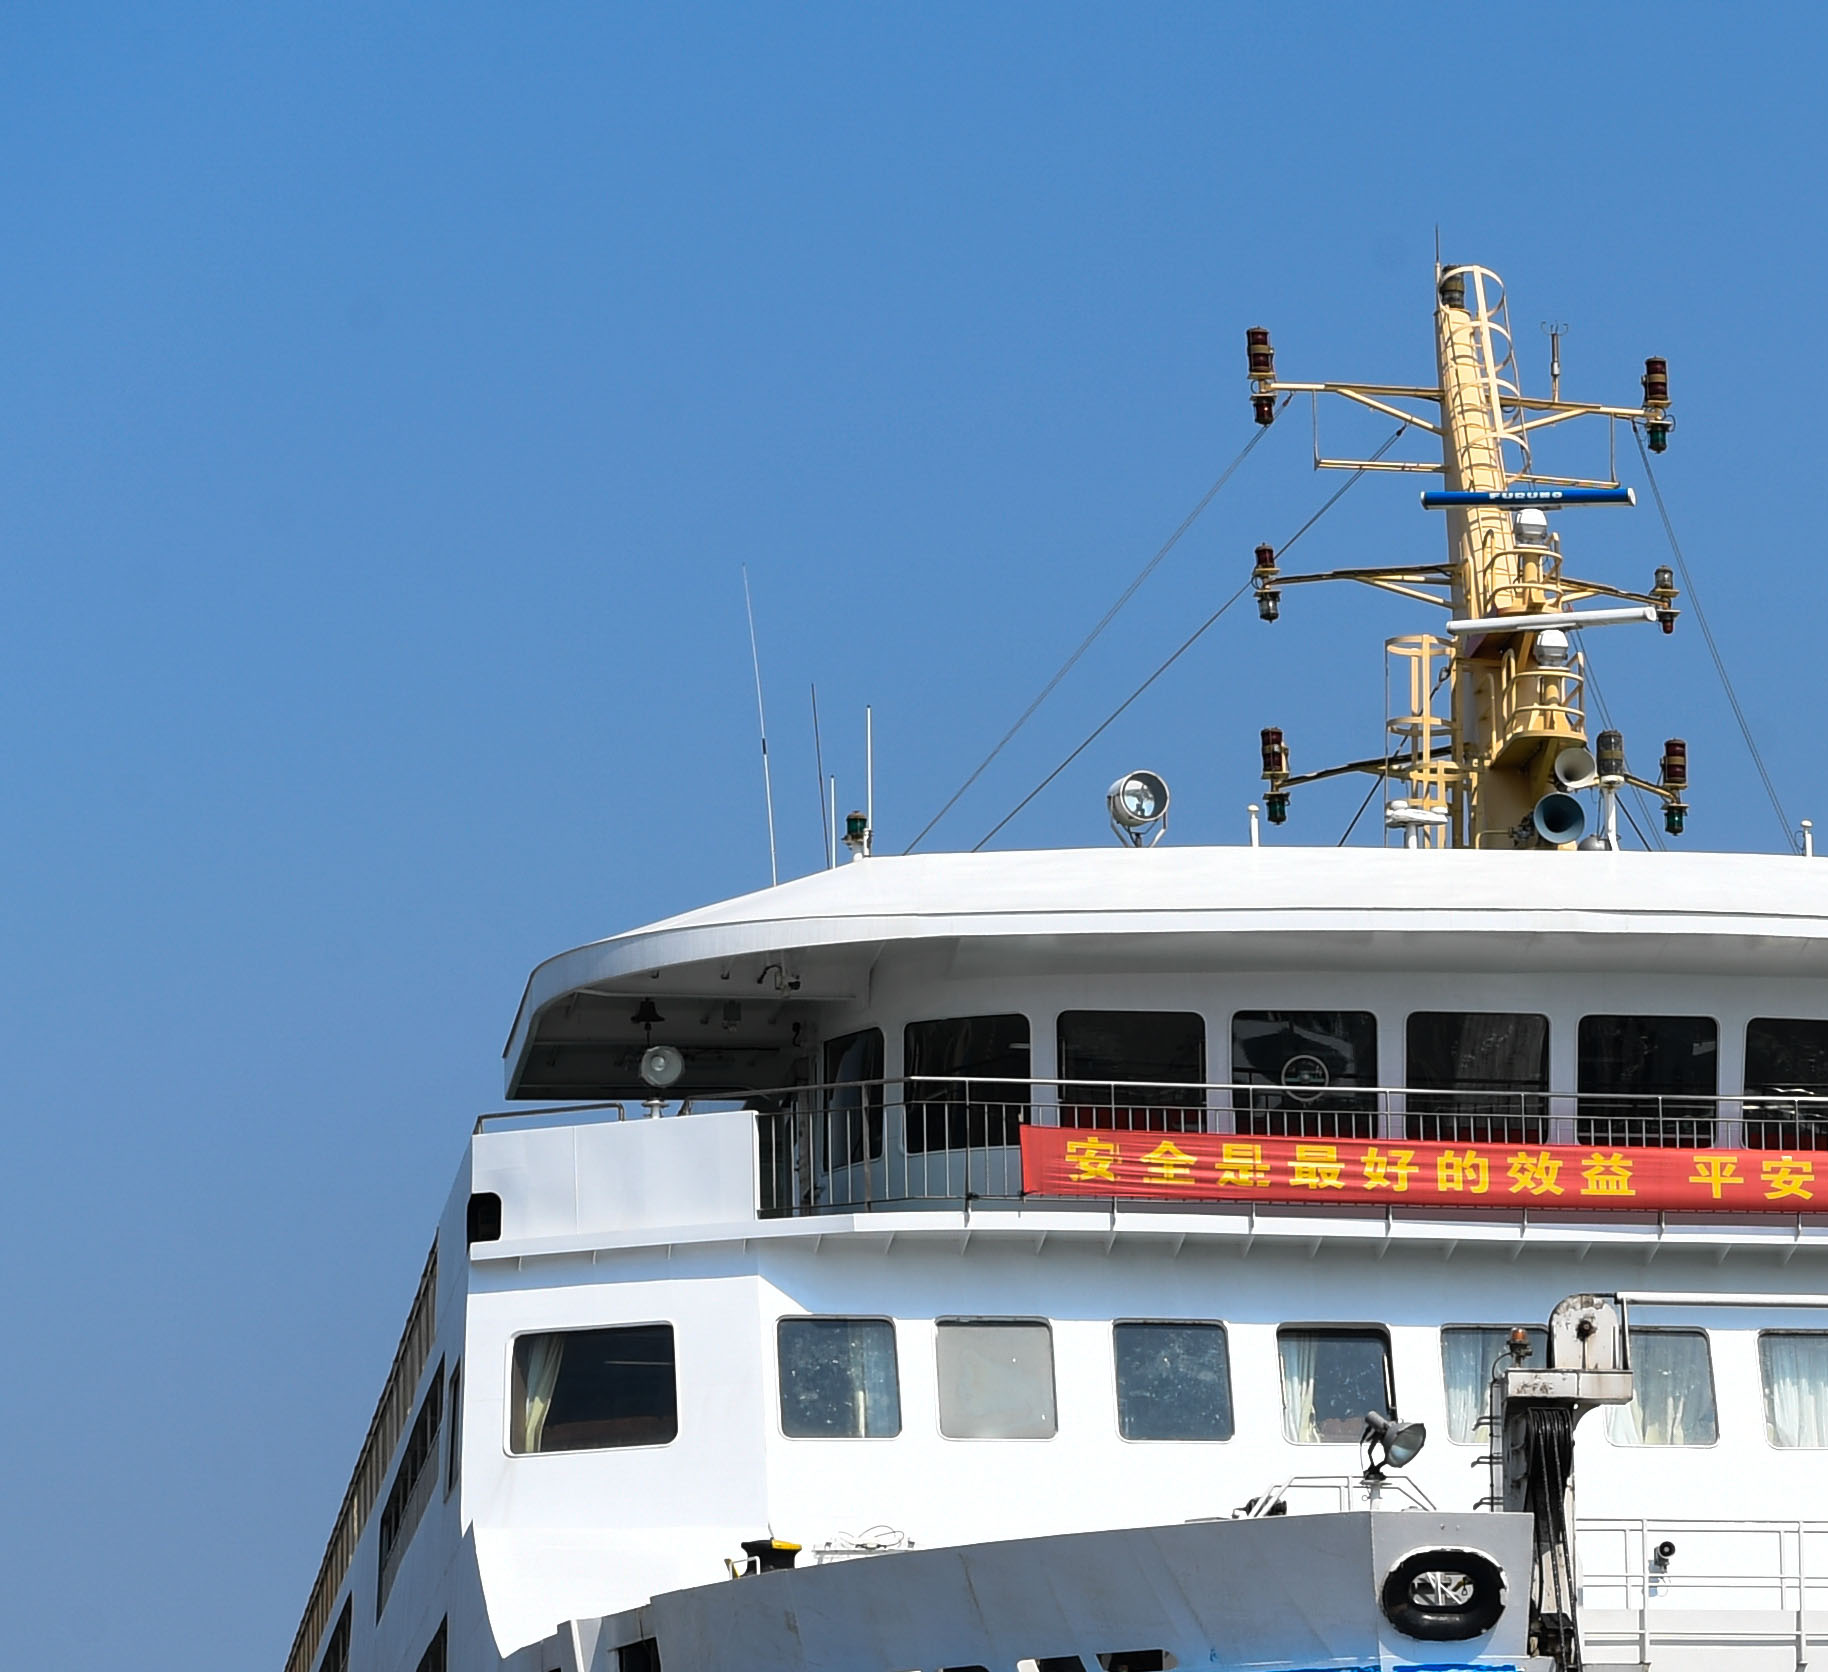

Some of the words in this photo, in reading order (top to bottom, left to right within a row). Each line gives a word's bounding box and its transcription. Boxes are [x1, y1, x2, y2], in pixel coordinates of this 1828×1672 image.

[1488, 491, 1563, 500] FURUNO
[1064, 1135, 1637, 1197] 安全是最好的效益
